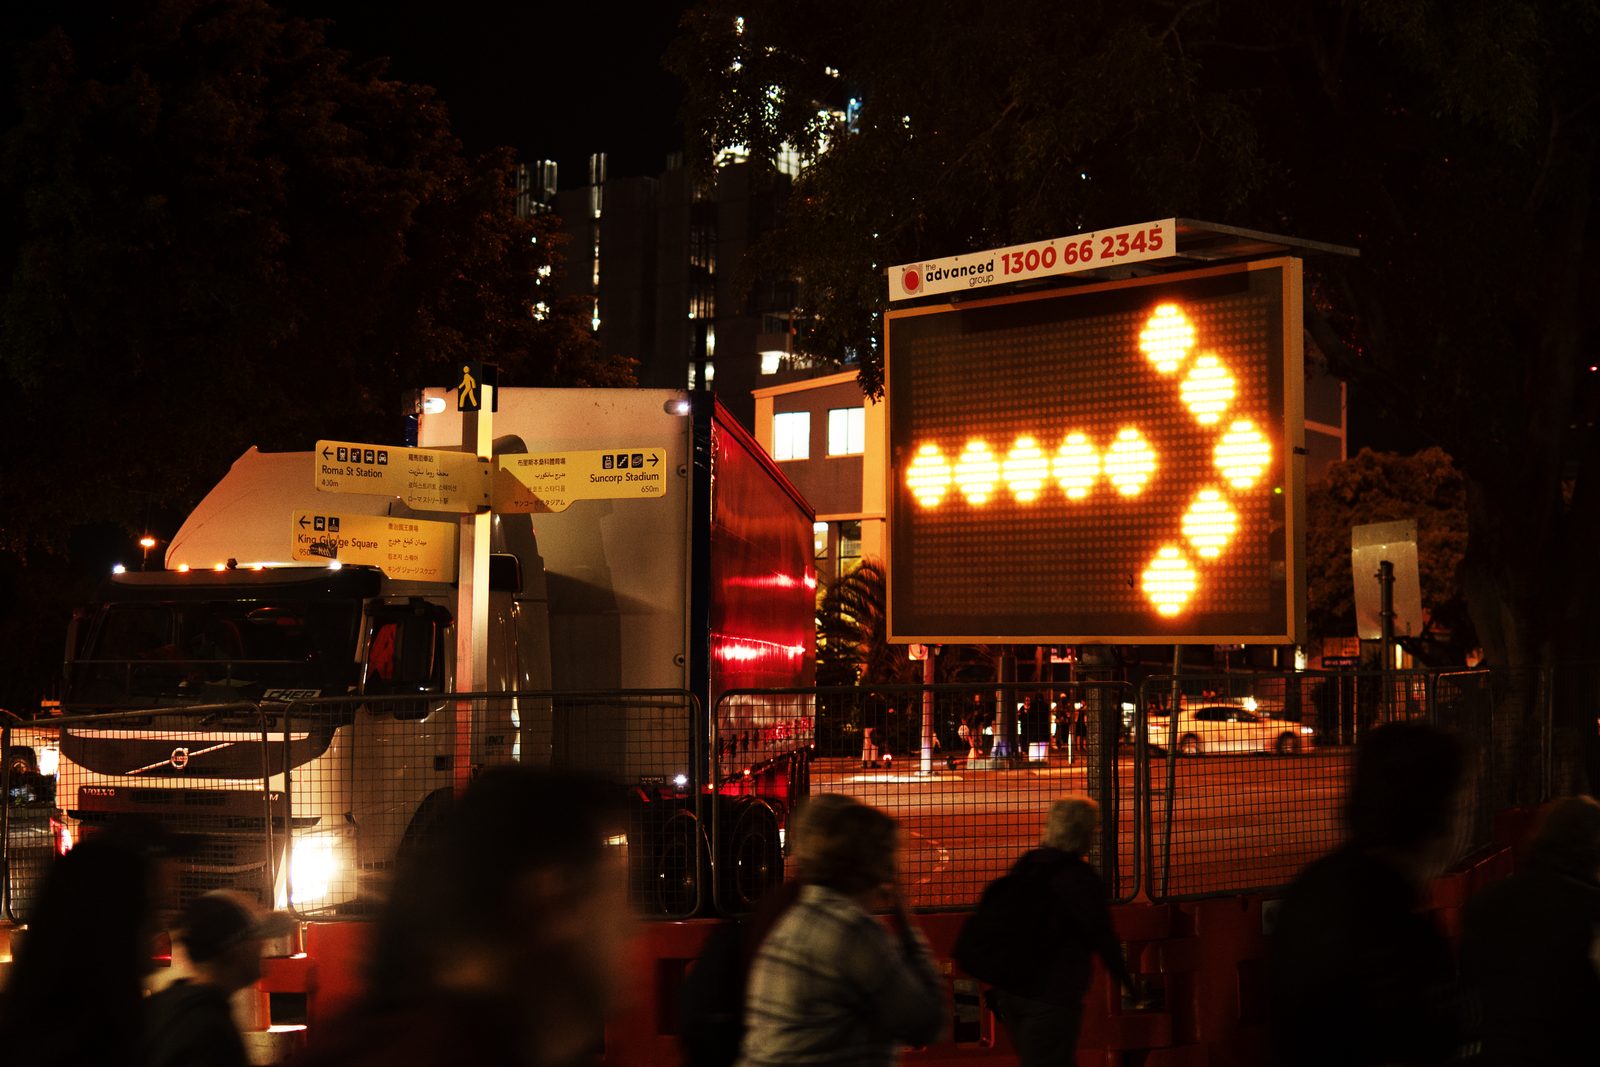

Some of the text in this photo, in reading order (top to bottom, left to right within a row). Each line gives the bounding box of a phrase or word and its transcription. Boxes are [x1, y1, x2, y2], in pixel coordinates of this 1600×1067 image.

[1001, 228, 1163, 276] 1300 66 2345
[926, 263, 936, 271] the
[926, 259, 994, 282] advanced
[969, 274, 994, 287] group
[322, 465, 383, 478] Roma St Station
[590, 472, 659, 484] Suncorp Stadium
[641, 485, 659, 493] 650m
[297, 533, 317, 545] King
[351, 538, 378, 549] Square
[299, 548, 311, 557] 950
